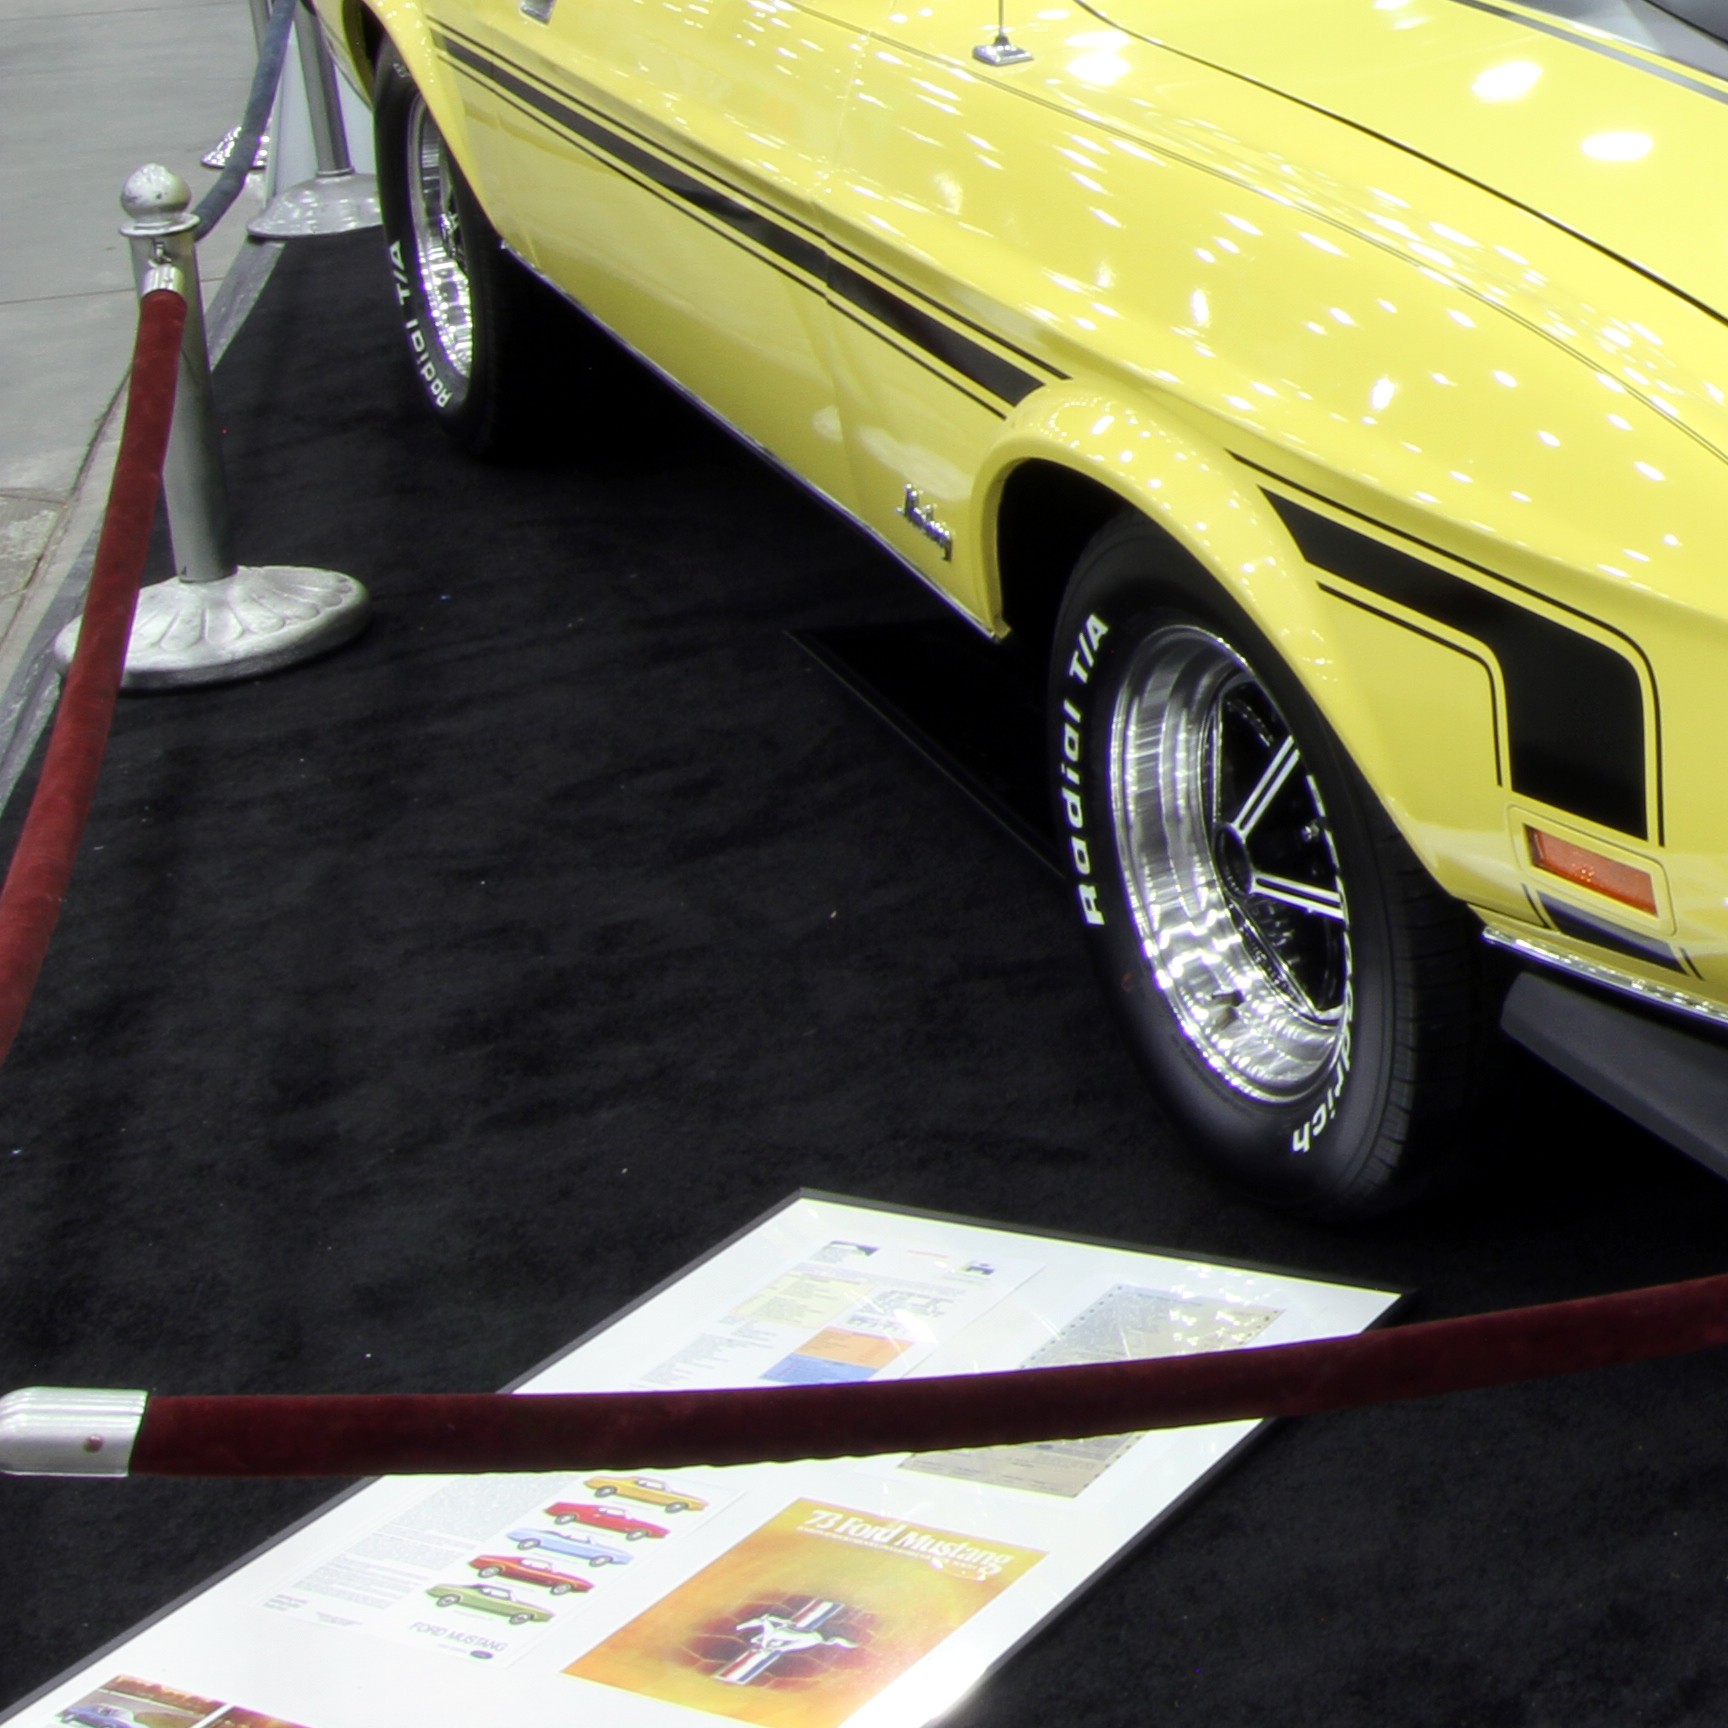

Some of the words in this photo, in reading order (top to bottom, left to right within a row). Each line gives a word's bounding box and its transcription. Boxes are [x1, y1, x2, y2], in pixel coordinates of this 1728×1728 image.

[1069, 612, 1110, 685] T/A
[1061, 701, 1105, 926] Radial
[837, 1516, 906, 1543] Ford
[893, 1530, 1014, 1576] Mustang
[446, 1630, 509, 1652] MUSTANG
